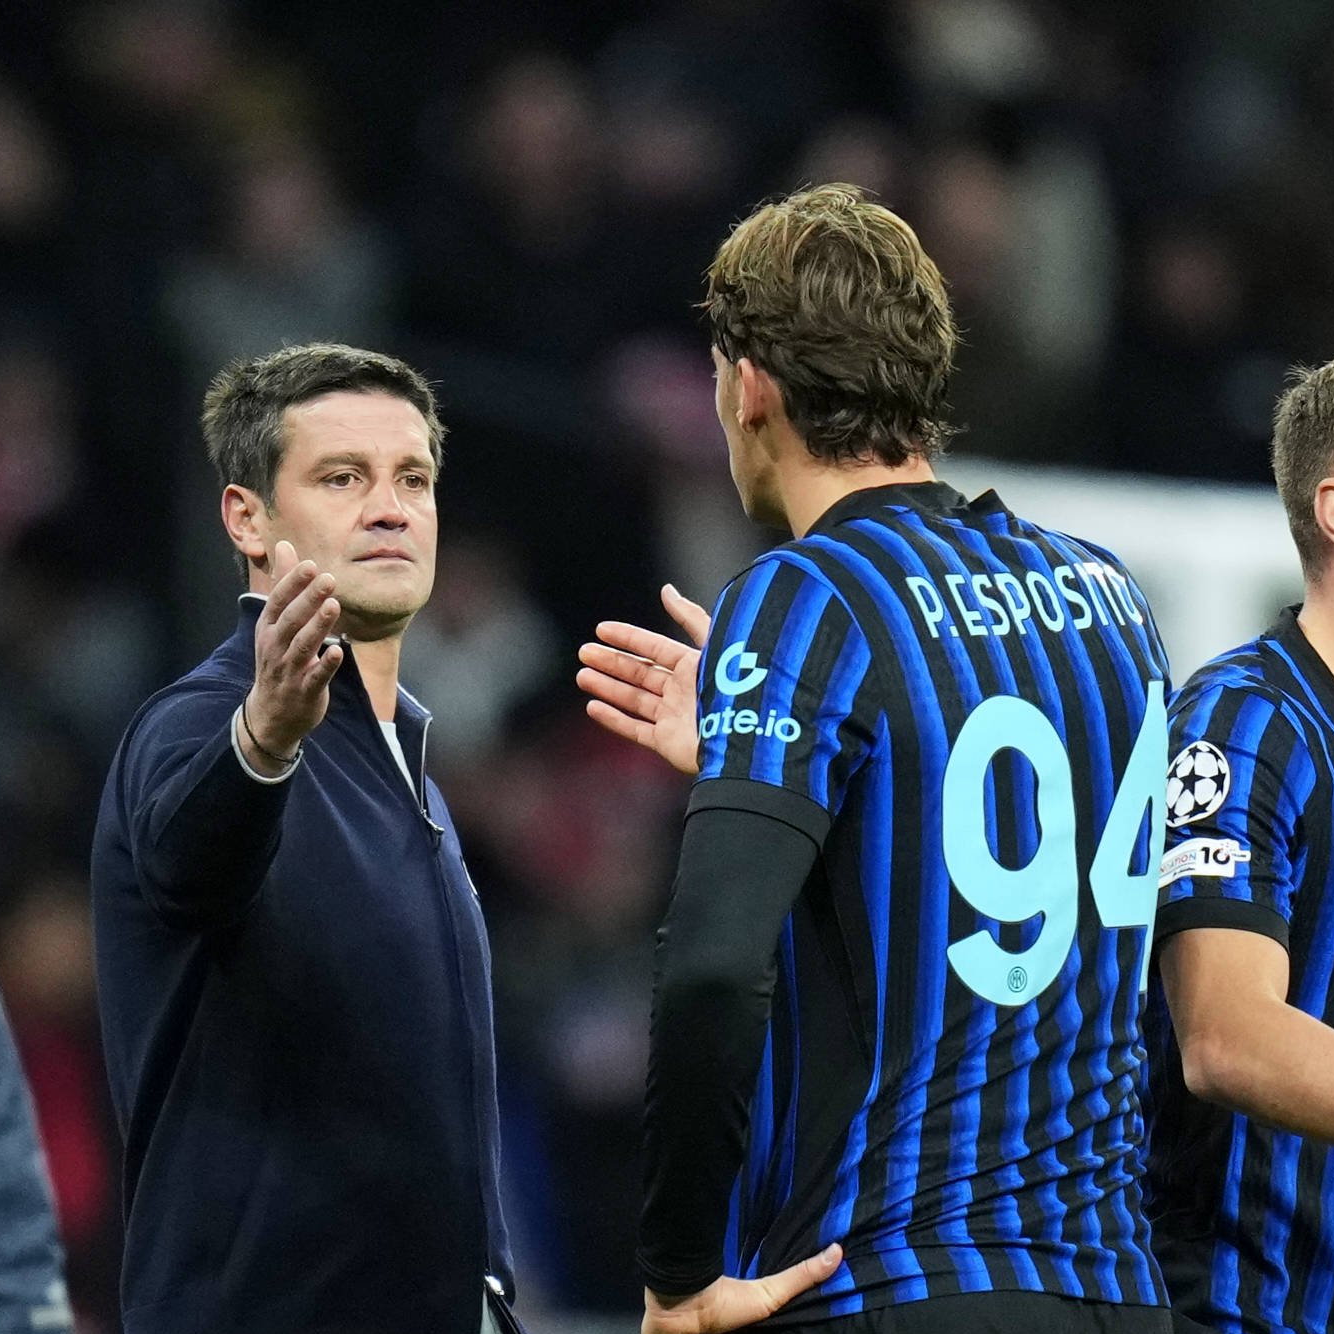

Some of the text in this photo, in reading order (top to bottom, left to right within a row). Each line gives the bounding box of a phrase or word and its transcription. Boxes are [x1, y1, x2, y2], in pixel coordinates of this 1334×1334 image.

[905, 562, 1143, 639] P.ESPOSITO
[698, 706, 801, 743] ate.io
[942, 680, 1169, 1006] 94
